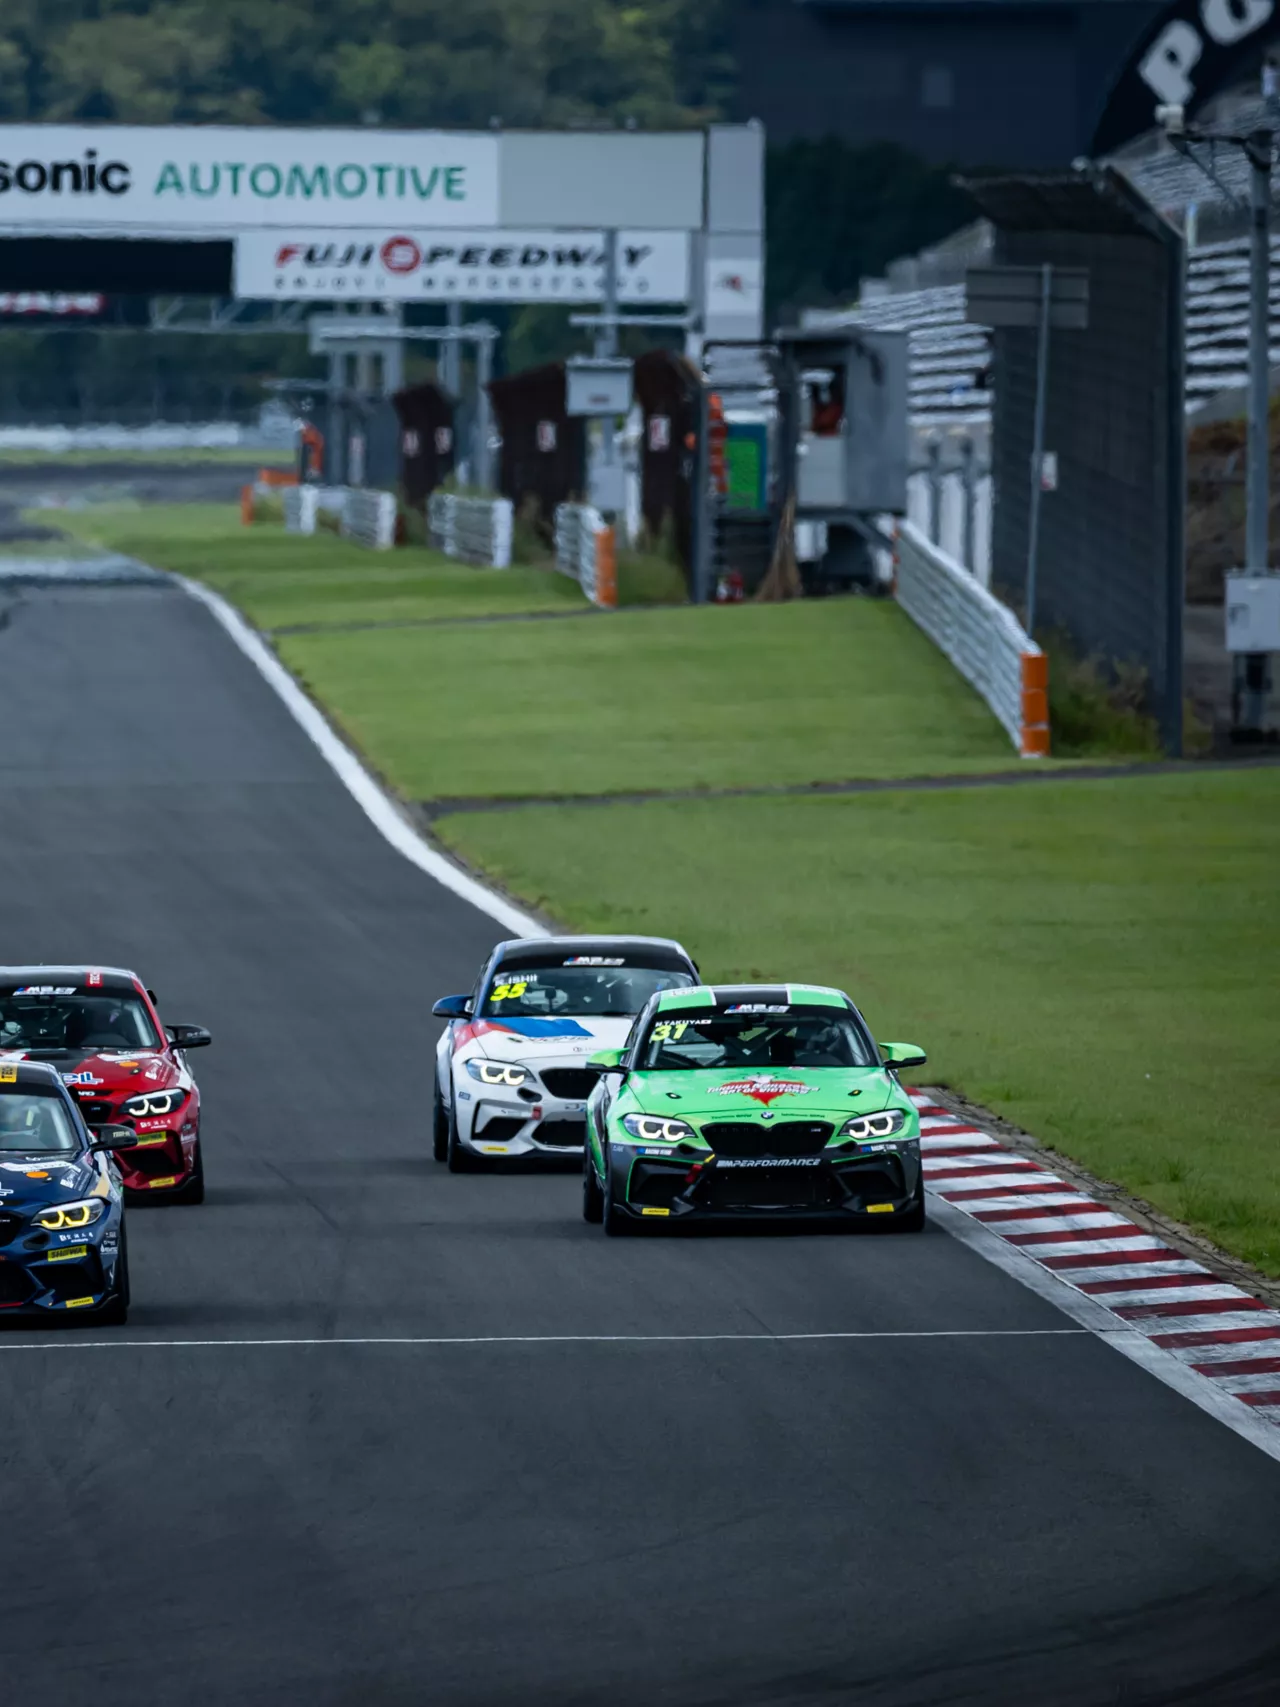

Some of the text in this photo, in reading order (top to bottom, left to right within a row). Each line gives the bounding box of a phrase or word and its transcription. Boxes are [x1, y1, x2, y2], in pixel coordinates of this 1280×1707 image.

[154, 162, 467, 200] AUTOMOTIVE
[275, 243, 374, 268] FUJI
[650, 1023, 688, 1042] 31
